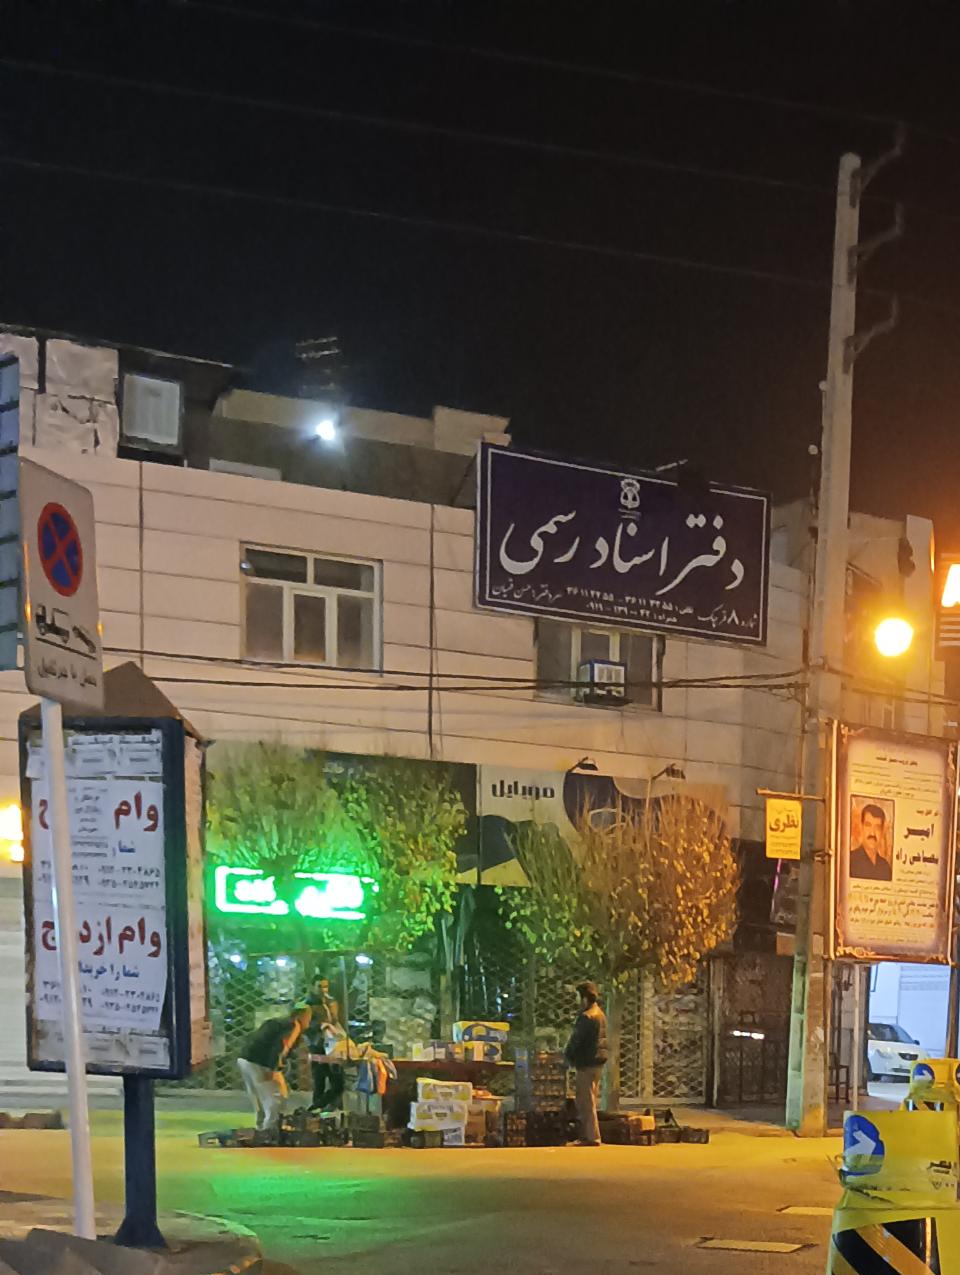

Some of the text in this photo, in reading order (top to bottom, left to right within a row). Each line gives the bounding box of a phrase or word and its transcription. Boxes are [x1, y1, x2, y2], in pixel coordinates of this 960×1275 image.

[499, 510, 745, 596] دفتر اسناد رسمی
[491, 779, 555, 800] موبایل
[114, 791, 159, 832] وام
[118, 917, 161, 957] وام
